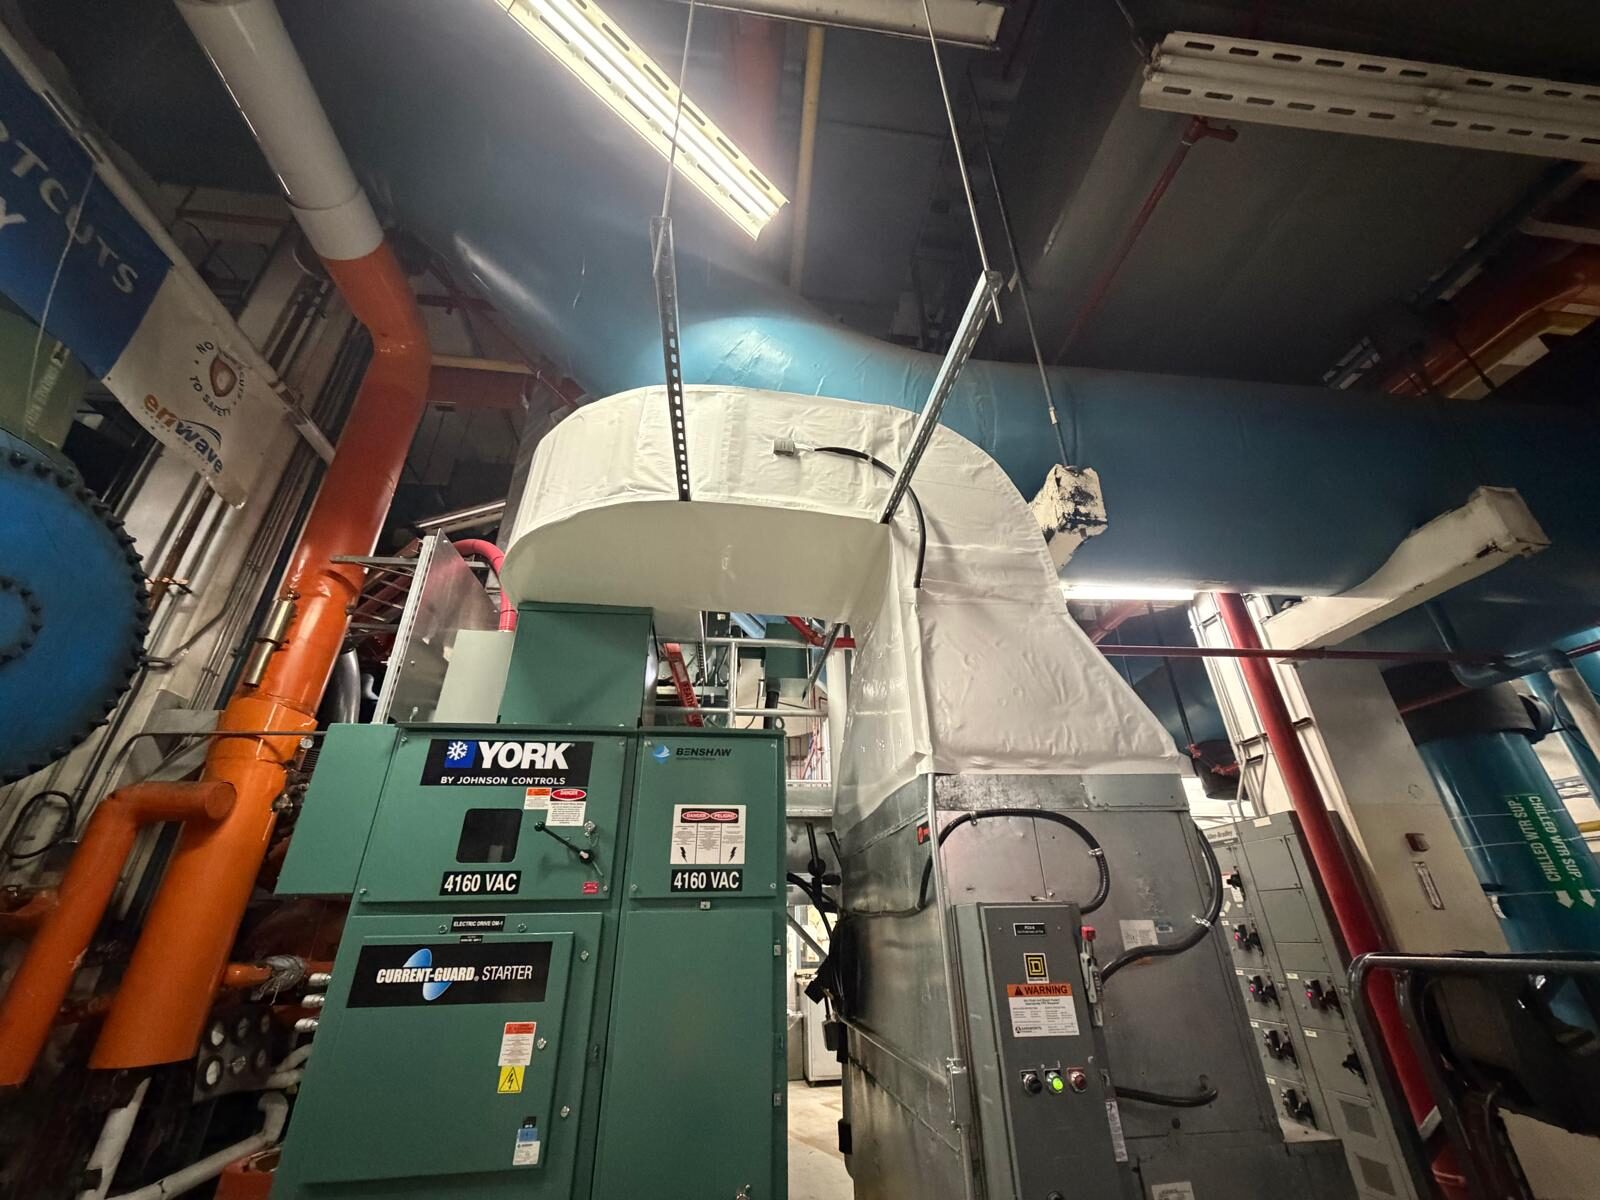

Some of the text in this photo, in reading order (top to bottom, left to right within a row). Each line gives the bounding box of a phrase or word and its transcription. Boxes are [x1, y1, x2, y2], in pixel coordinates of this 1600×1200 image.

[0, 118, 139, 295] TCUTS
[196, 341, 214, 354] NO
[189, 375, 203, 392] TO
[143, 393, 223, 475] enwave
[478, 741, 571, 770] YORK
[676, 747, 732, 757] BENSHAW
[440, 776, 566, 785] BY JOHNSON CONTROLS
[1518, 819, 1541, 841] WTR
[1528, 795, 1558, 833] CHILLED
[1550, 835, 1570, 857] WTR
[1529, 842, 1562, 882] CHILLED
[443, 872, 518, 893] 4160 VAC
[673, 871, 740, 889] 4160 VAC
[376, 964, 533, 984] CURRENT-GUARD STARTER
[1024, 985, 1068, 996] WARNING
